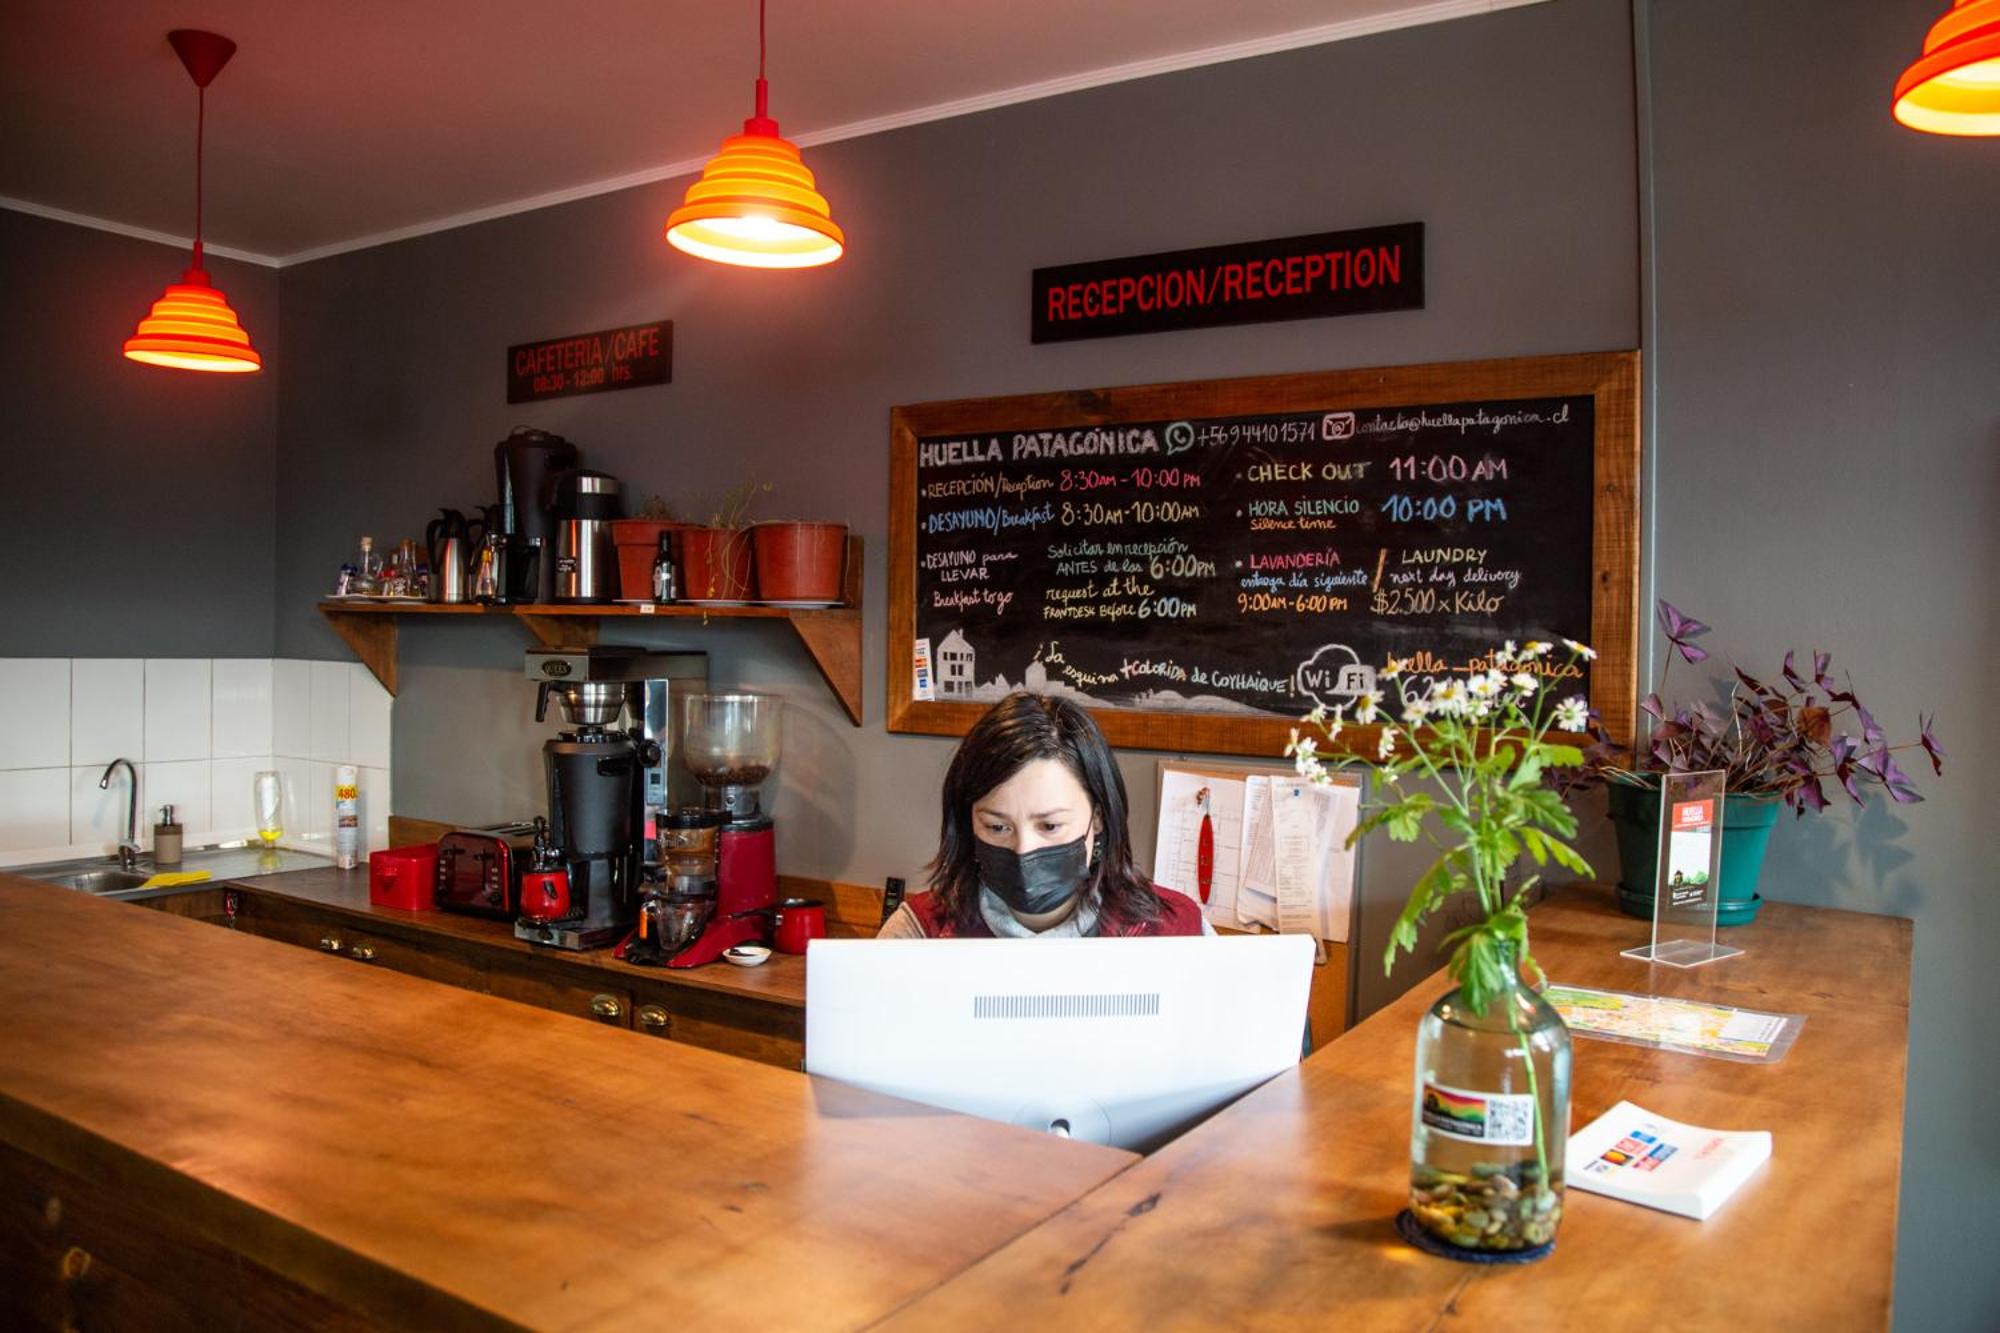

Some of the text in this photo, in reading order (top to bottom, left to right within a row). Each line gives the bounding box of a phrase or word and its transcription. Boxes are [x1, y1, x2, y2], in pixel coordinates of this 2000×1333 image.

[1048, 245, 1400, 321] RECEPCION/RECEPTION
[919, 427, 1160, 468] HUELLA PATAGÓNICA
[1247, 461, 1372, 482] CHECK OUT
[1248, 500, 1289, 517] HORA
[1381, 493, 1508, 522] 10:00 PM
[1297, 515, 1337, 530] time
[926, 548, 977, 570] DESAYUNO
[1250, 547, 1341, 570] LAVANDERÍA
[1402, 547, 1488, 565] LAUNDRY
[941, 567, 991, 583] LLEVAR
[1056, 559, 1098, 577] ANTES
[1104, 560, 1119, 574] de
[1429, 565, 1456, 588] day
[1046, 575, 1156, 608] request at the
[1454, 588, 1506, 616] Kilo
[997, 591, 1015, 616] go
[1191, 665, 1209, 685] de
